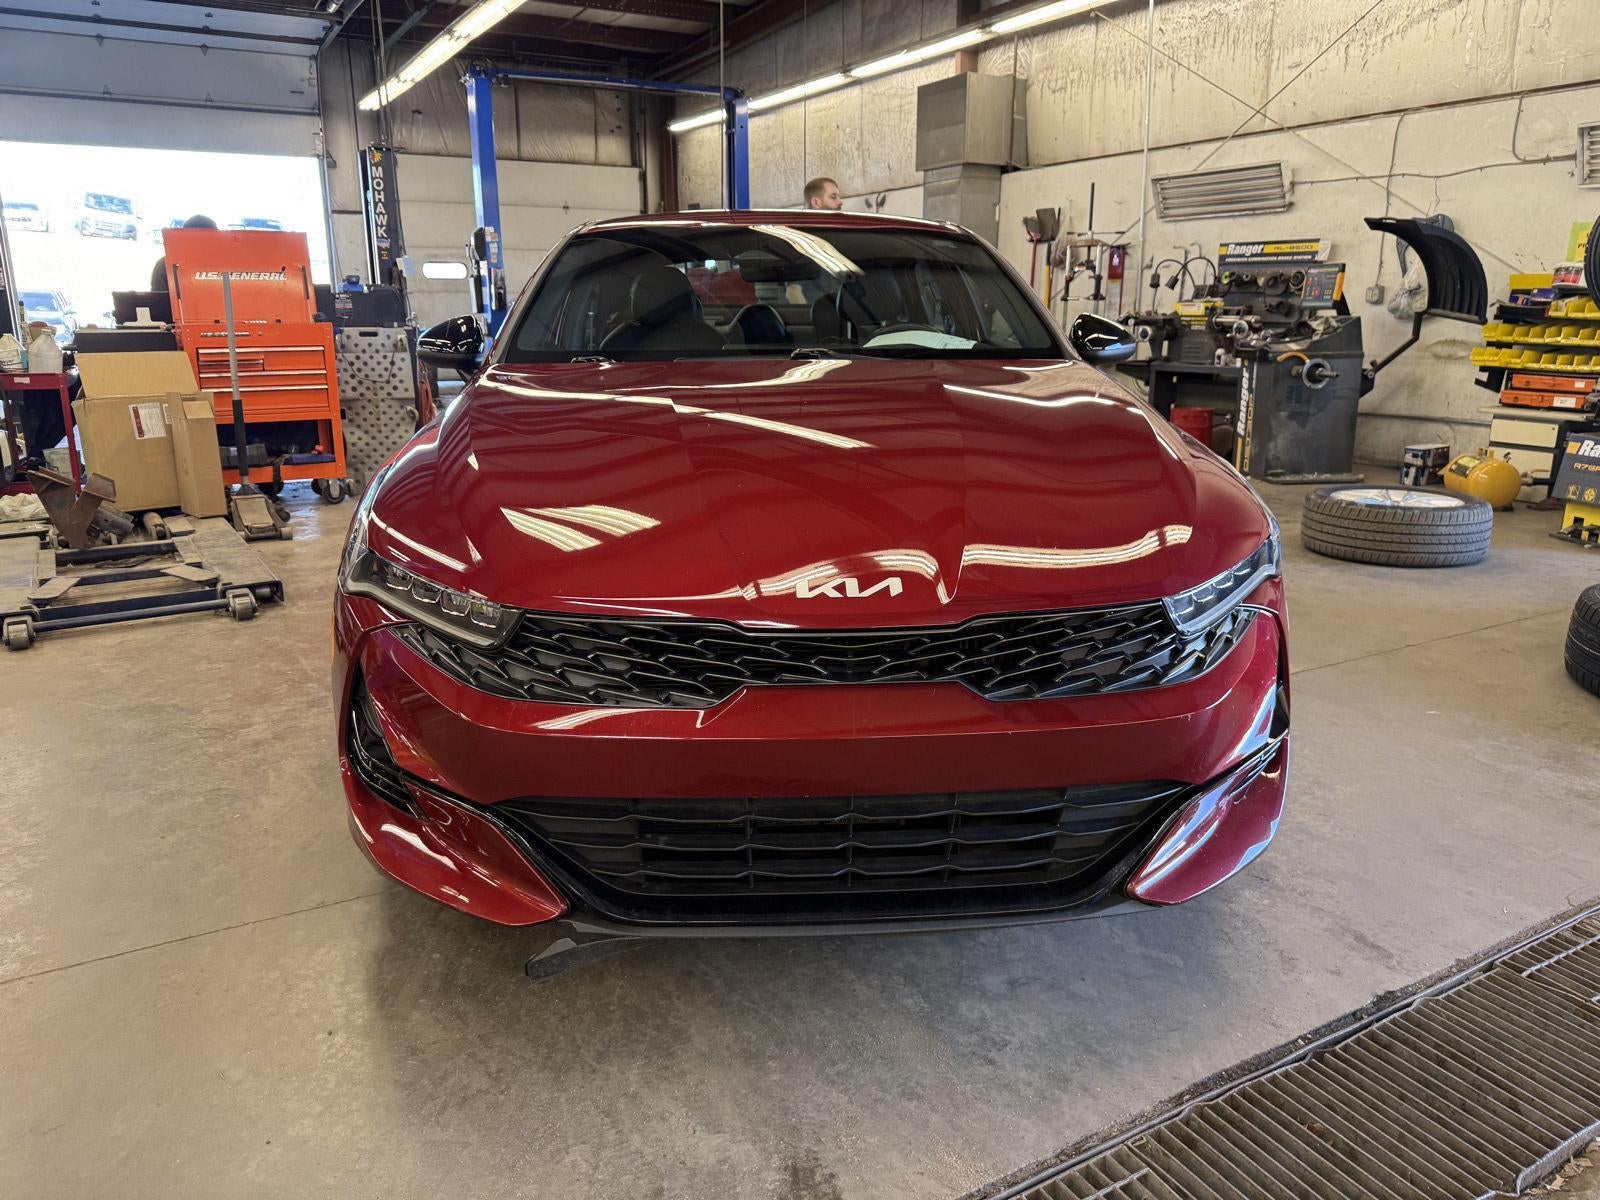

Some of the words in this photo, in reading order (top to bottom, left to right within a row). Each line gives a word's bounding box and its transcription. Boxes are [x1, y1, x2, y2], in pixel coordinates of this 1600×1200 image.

[371, 166, 388, 238] MOHAWK
[1227, 243, 1264, 256] Ranger
[1237, 366, 1249, 437] Ranger
[1578, 440, 1600, 458] Ra
[796, 577, 903, 599] KIA
